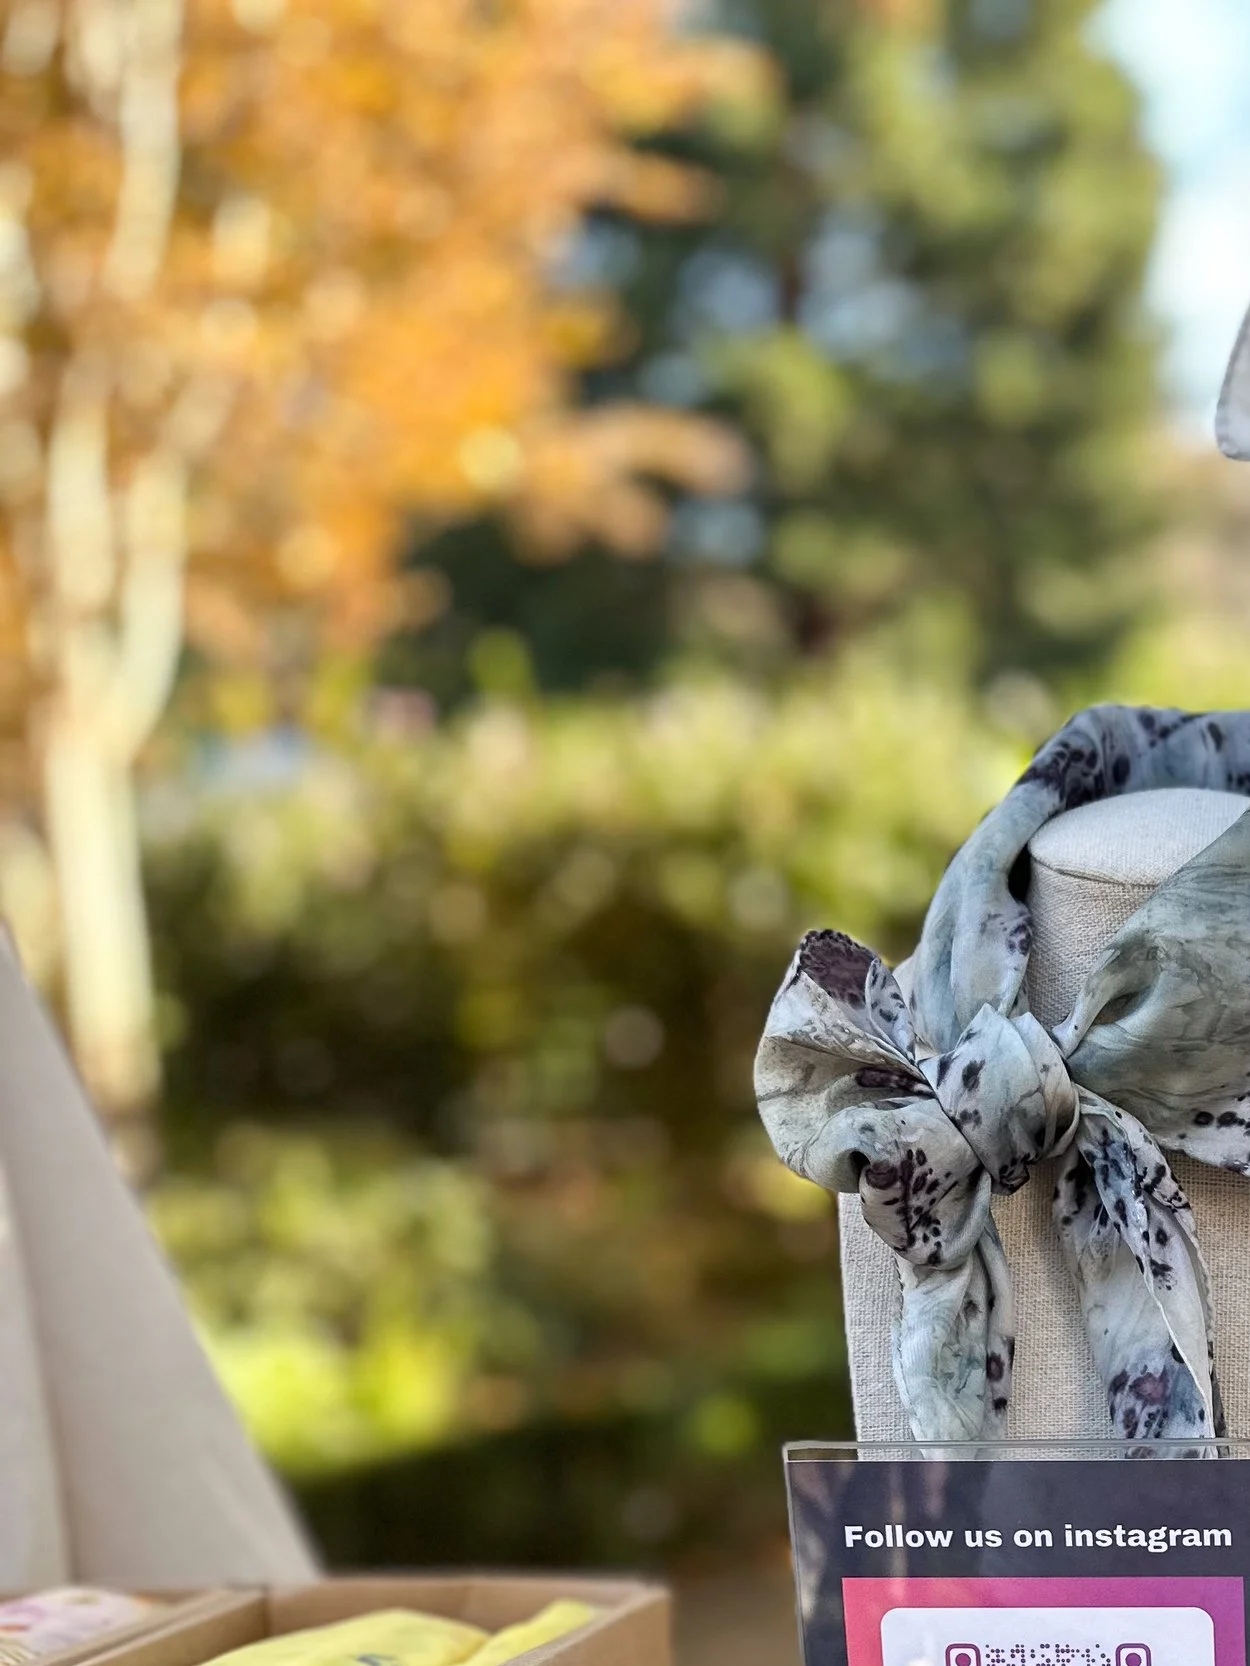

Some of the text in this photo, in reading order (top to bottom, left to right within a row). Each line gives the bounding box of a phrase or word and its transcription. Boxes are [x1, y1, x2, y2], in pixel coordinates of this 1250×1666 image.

[843, 1522, 1233, 1553] Follow us on instagram
